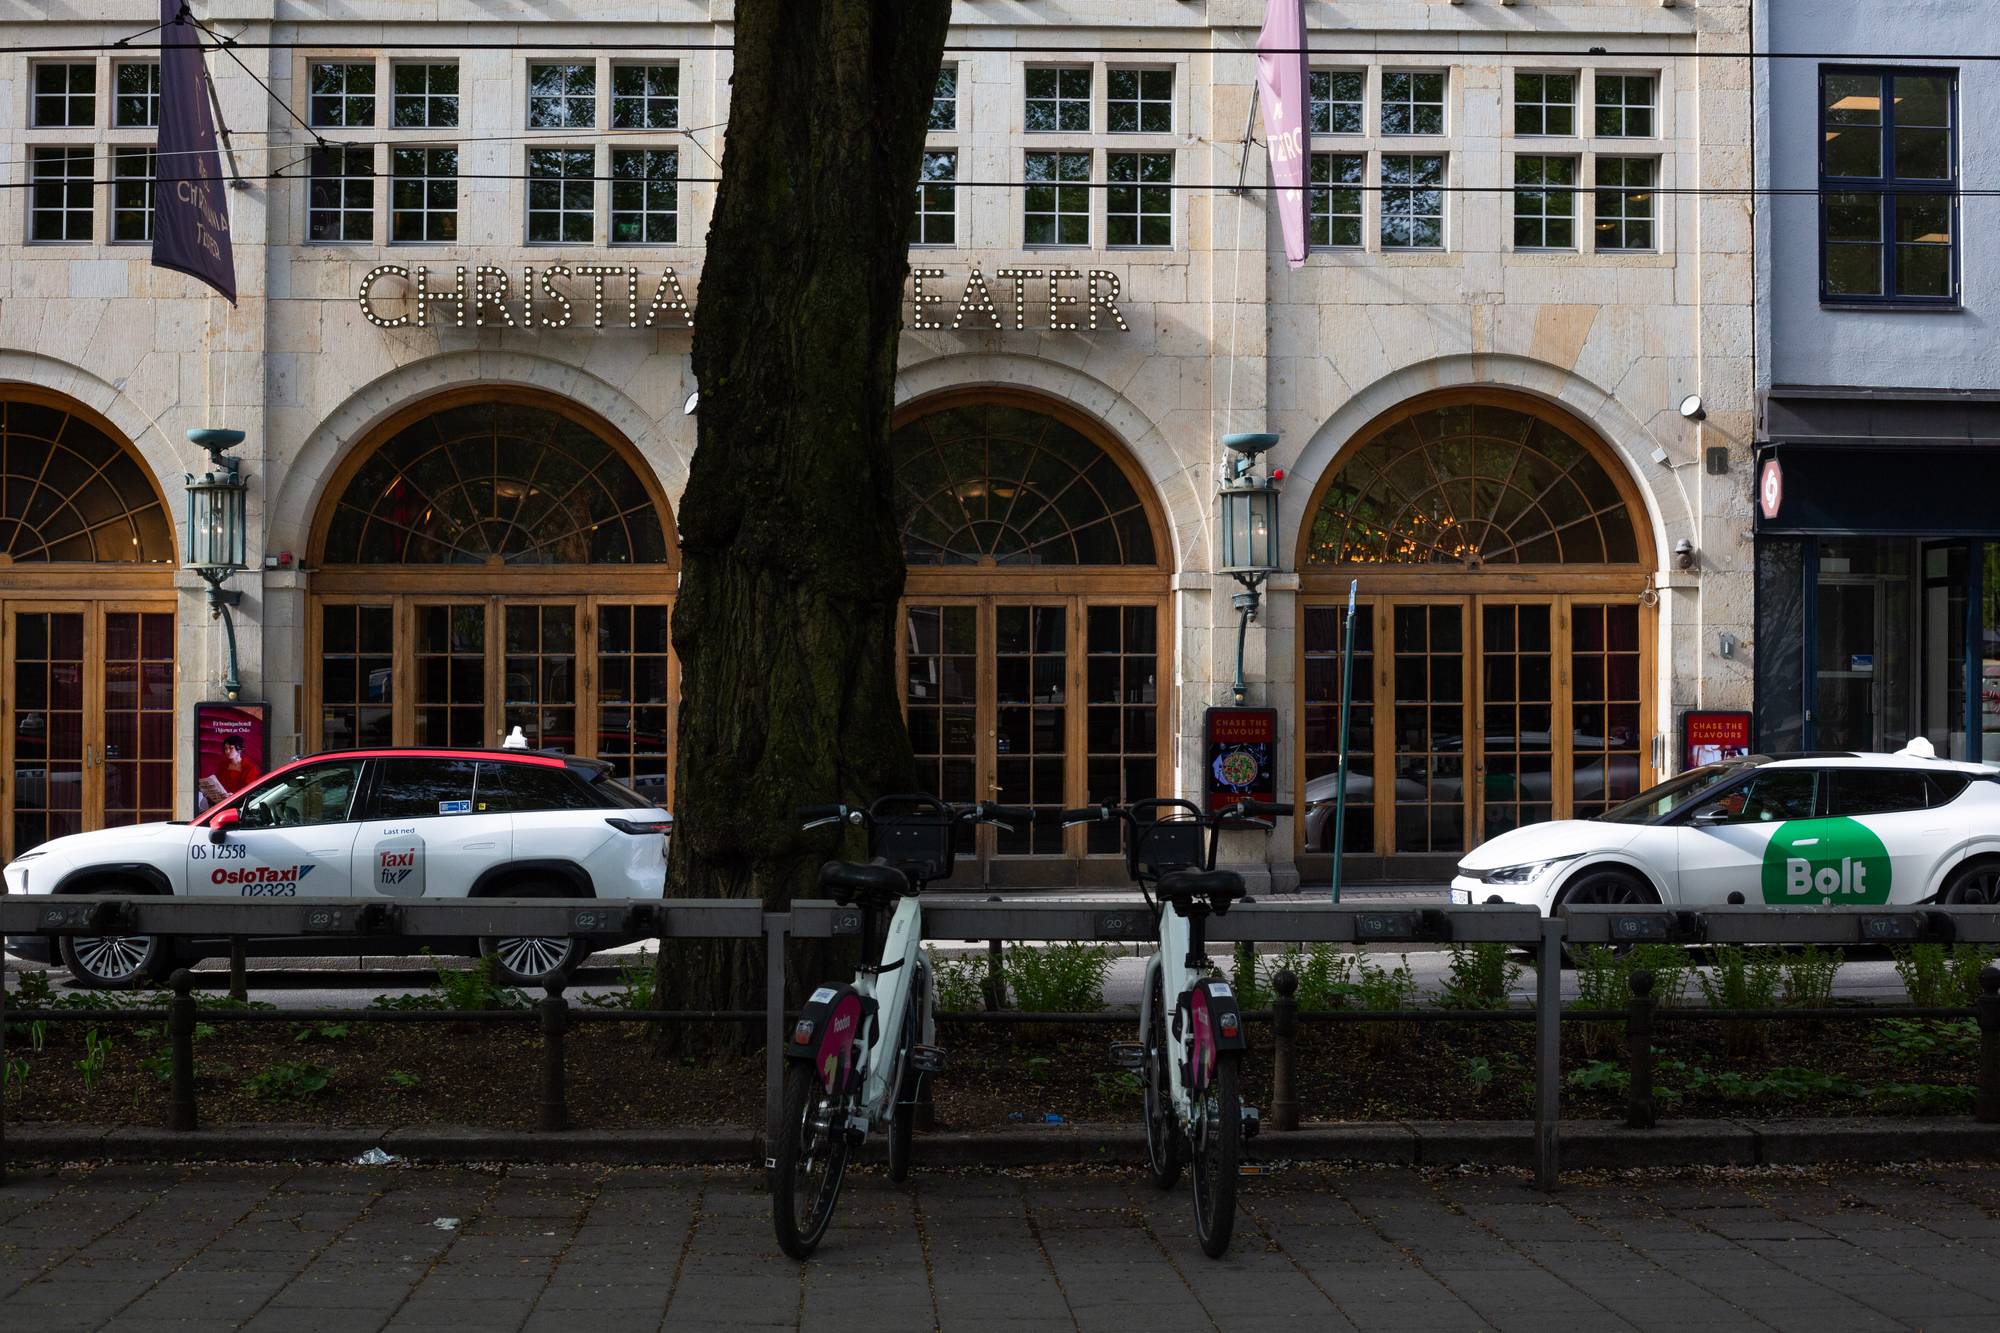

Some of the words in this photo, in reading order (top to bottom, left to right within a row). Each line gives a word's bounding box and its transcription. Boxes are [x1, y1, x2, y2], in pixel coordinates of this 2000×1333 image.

[359, 265, 695, 327] CHRISTIA
[914, 269, 1130, 332] EATER
[1216, 728, 1266, 736] FLAVOURS
[191, 844, 206, 859] OS
[212, 844, 246, 859] 12558
[380, 848, 415, 868] Taxi
[211, 864, 298, 885] OsloTaxi
[381, 868, 397, 885] fix
[1787, 857, 1867, 896] Bolt
[241, 882, 297, 896] 02323
[48, 911, 64, 921] 24
[313, 913, 329, 923] 23
[580, 915, 594, 926] 22
[845, 917, 857, 926] 21
[1107, 919, 1121, 928] 20
[1368, 920, 1381, 929] 19
[1875, 922, 1886, 930] 17
